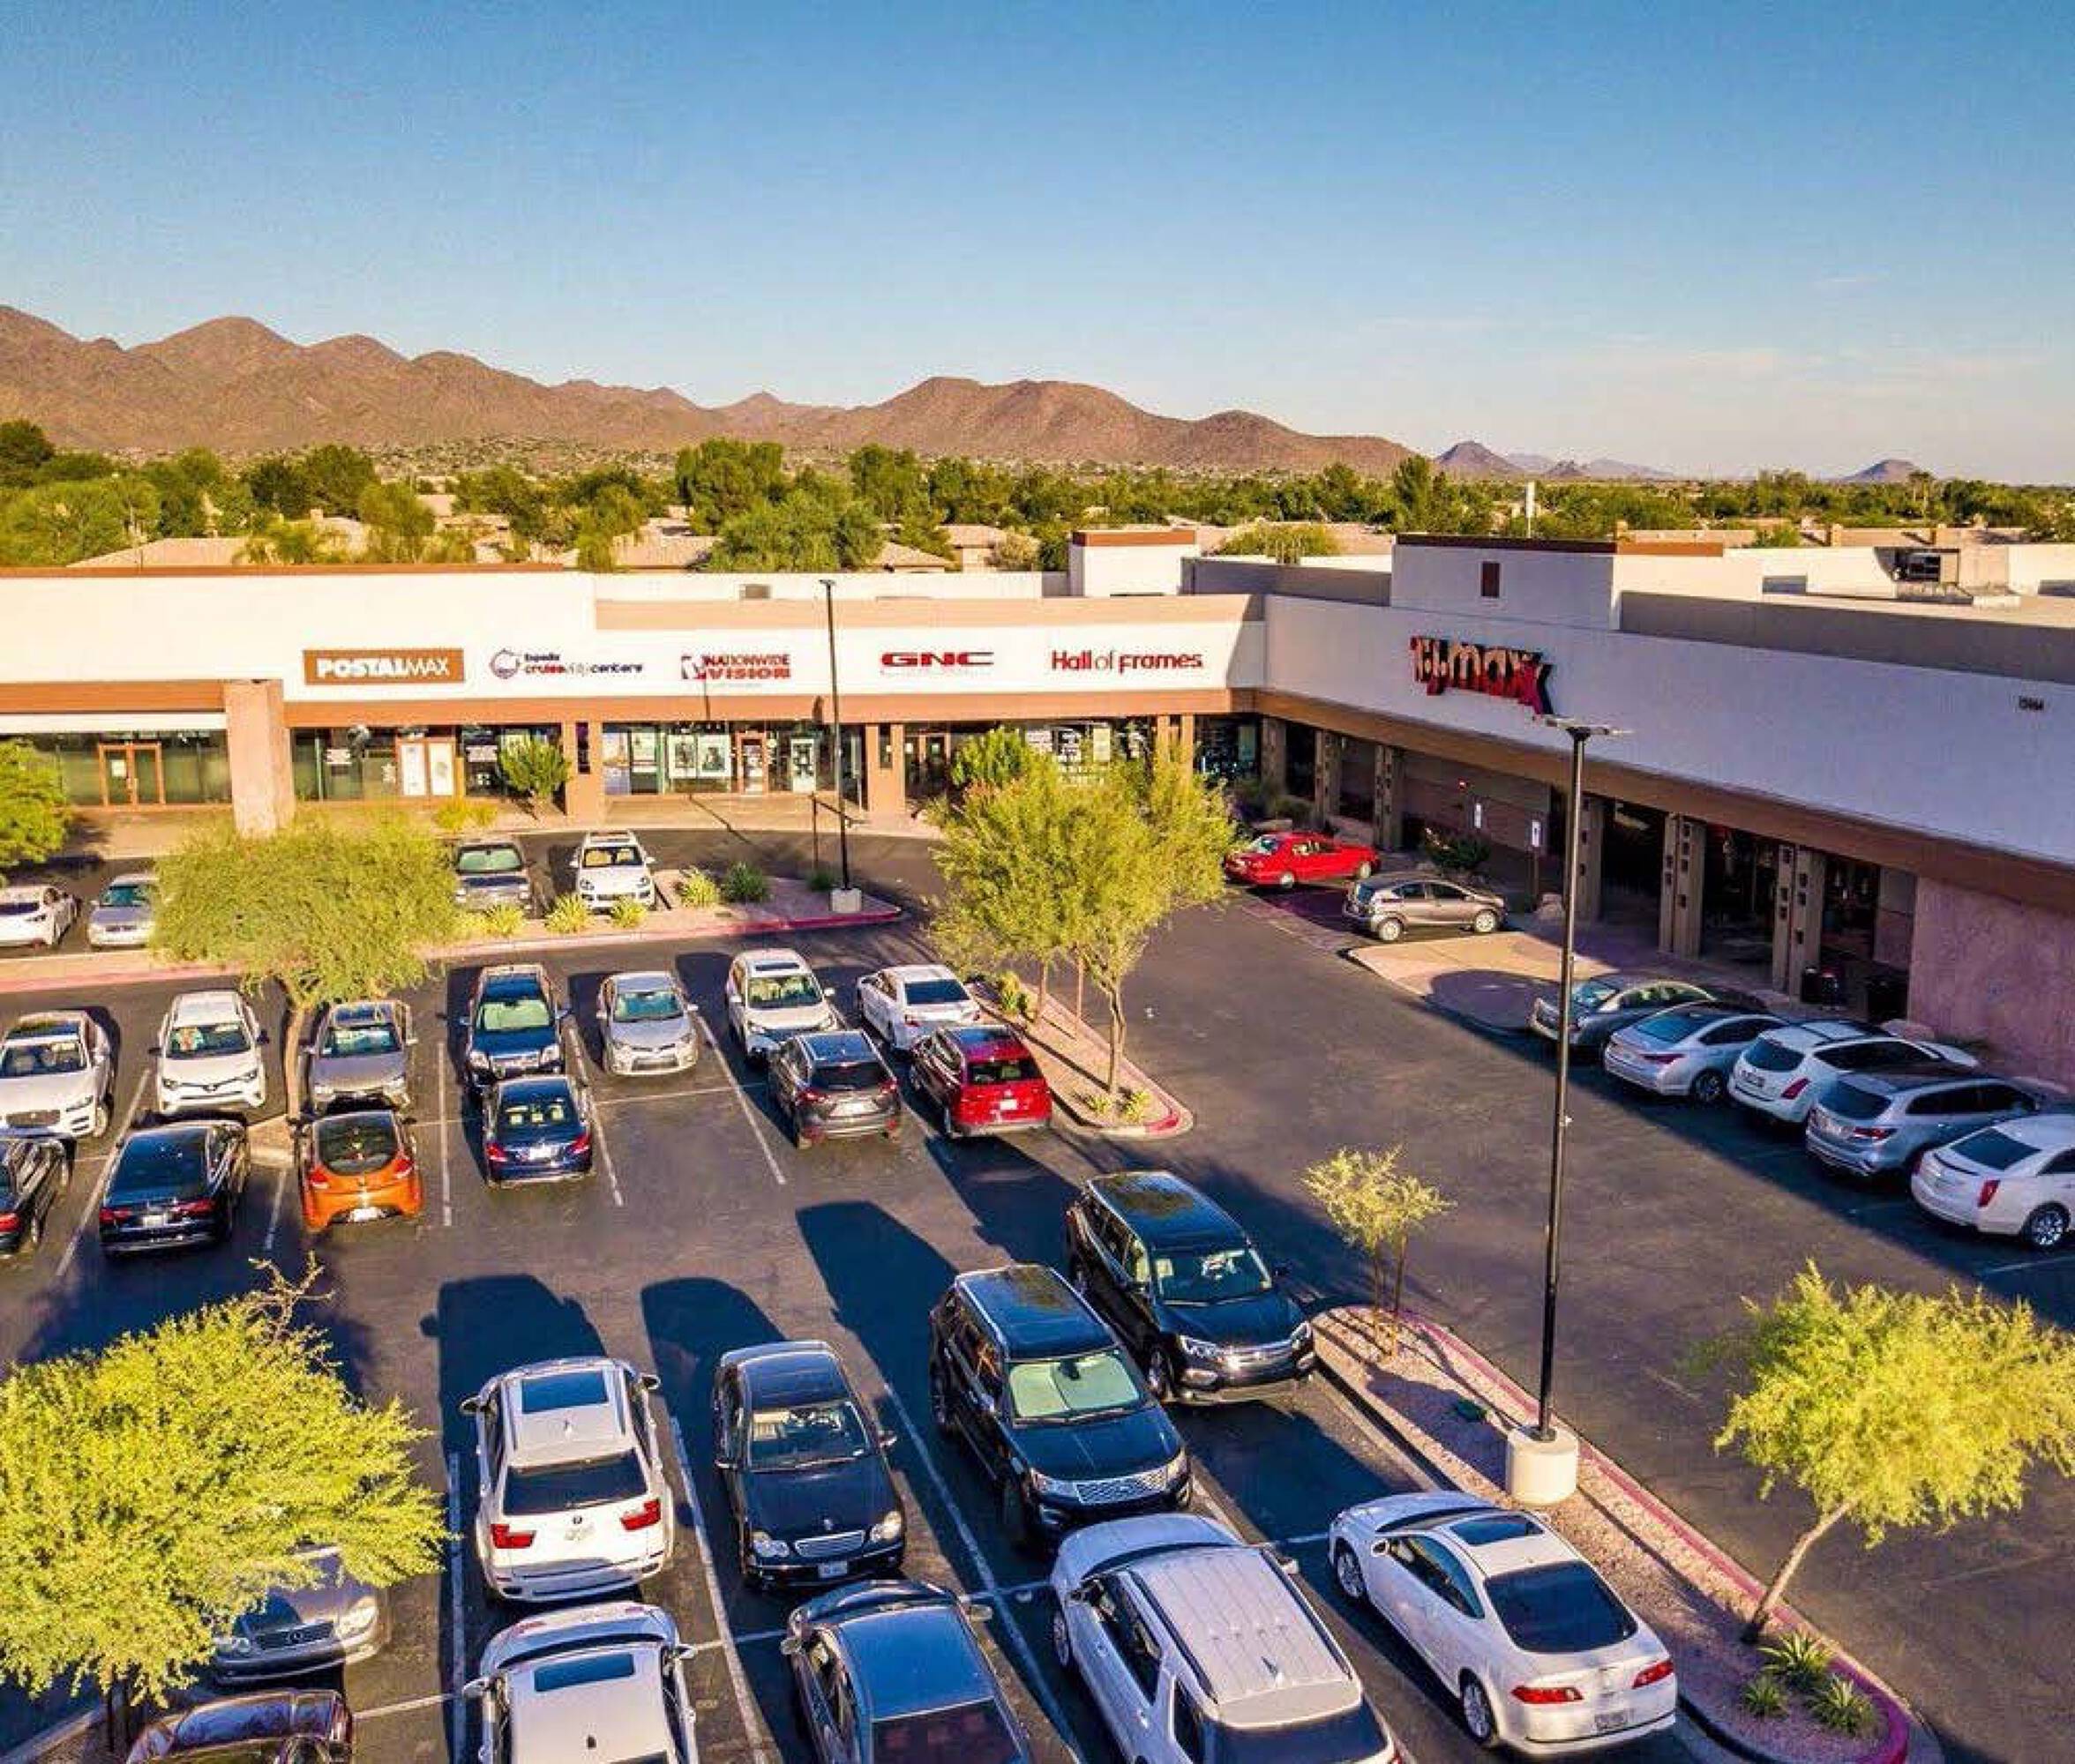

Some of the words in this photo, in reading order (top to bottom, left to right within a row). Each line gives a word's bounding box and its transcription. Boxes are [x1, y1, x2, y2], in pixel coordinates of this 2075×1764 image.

[701, 654, 790, 666] NATIONWIDE
[880, 652, 994, 667] GNC
[1051, 650, 1091, 670] Hall
[1095, 651, 1114, 670] of
[707, 668, 791, 679] VISION
